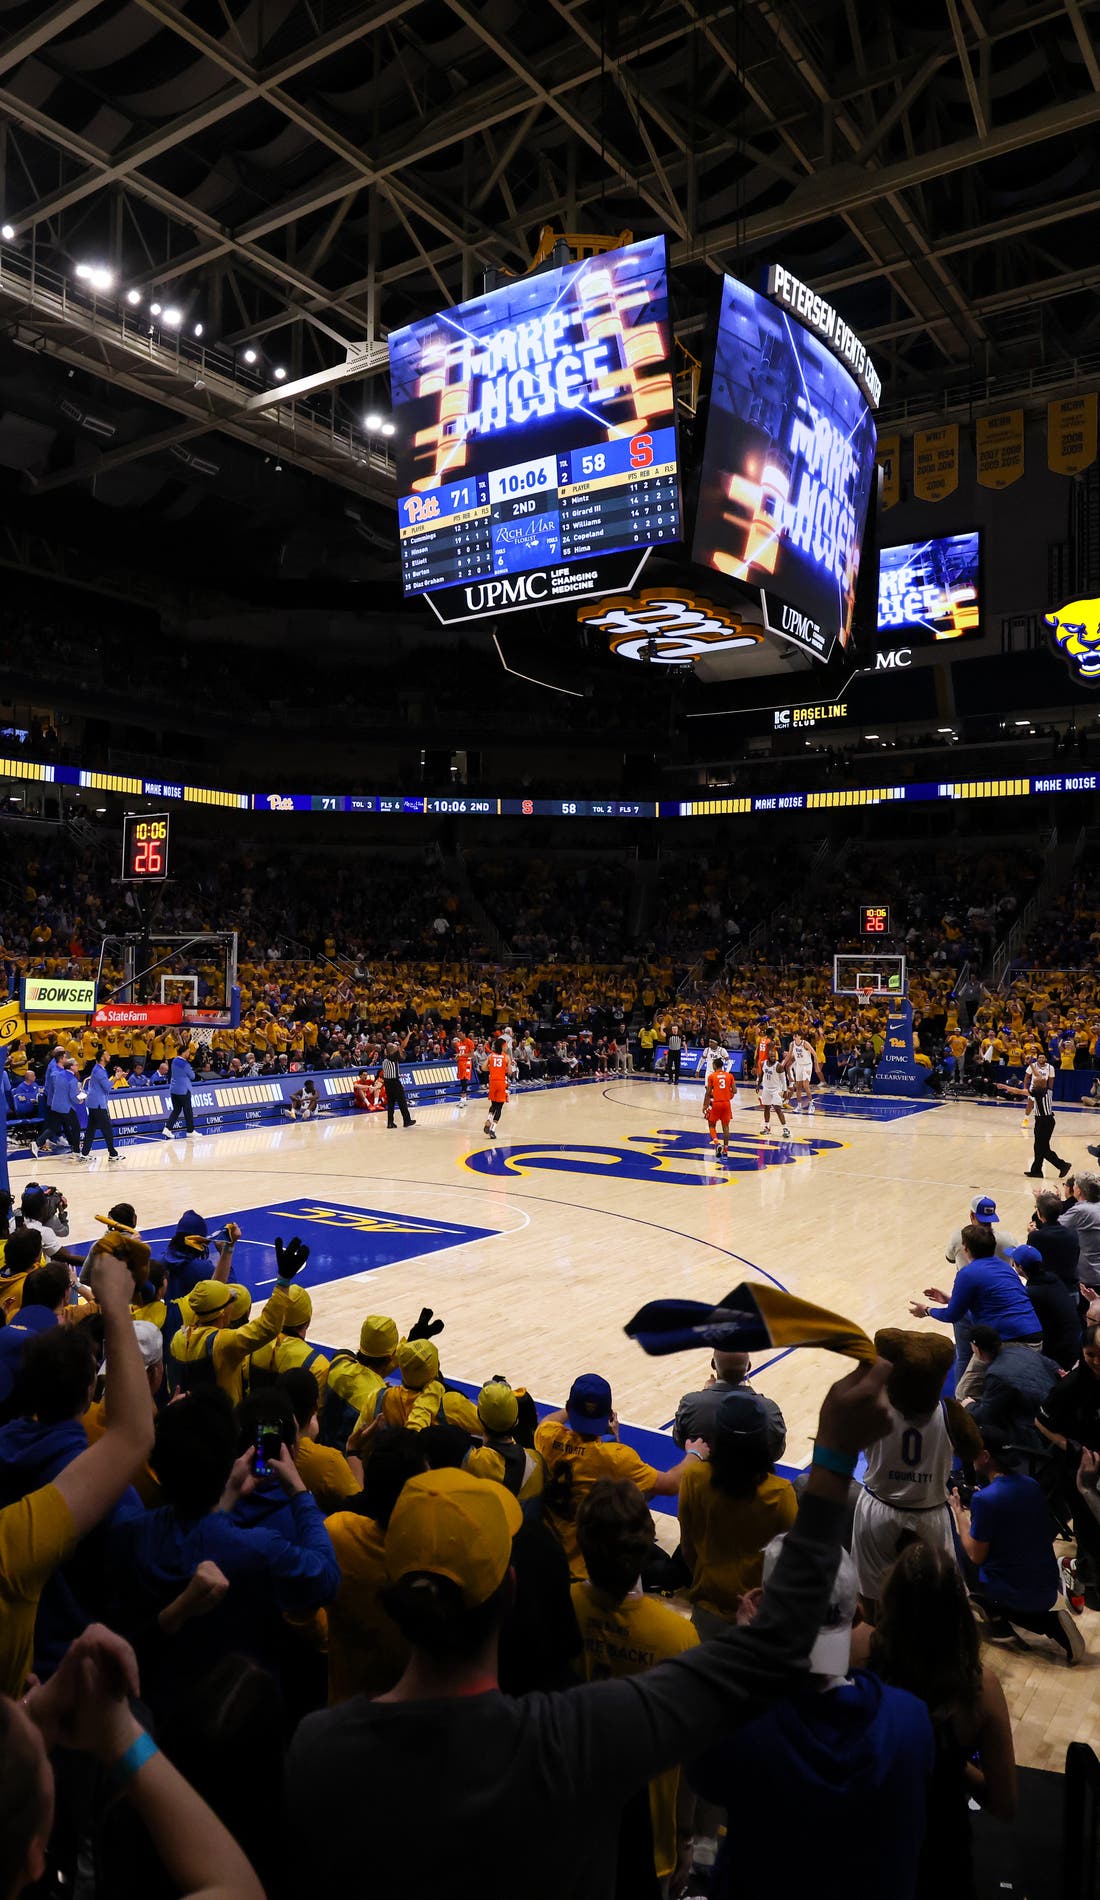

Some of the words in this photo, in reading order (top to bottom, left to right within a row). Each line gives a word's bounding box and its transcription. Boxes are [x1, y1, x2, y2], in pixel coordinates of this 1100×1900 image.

[775, 264, 836, 337] PETERSEN
[834, 316, 866, 374] EVENTS
[582, 453, 605, 474] 58
[630, 434, 653, 469] S
[499, 468, 547, 495] 10:06
[562, 472, 568, 482] 2
[572, 483, 590, 492] PLAYER
[480, 492, 487, 502] 3
[572, 495, 589, 504] Mintz
[404, 496, 440, 524] Pitt
[451, 487, 469, 508] 71
[512, 500, 536, 515] 2ND
[572, 506, 593, 516] Girard
[573, 518, 601, 528] Williams
[411, 533, 437, 544] Cummings
[574, 529, 604, 541] Copeland
[550, 544, 556, 554] 7
[574, 545, 590, 553] Hima
[498, 556, 504, 565] 6
[551, 568, 569, 578] LIFE
[552, 571, 598, 586] CHANGING
[464, 572, 548, 610] UPMC
[552, 580, 594, 594] MEDICINE
[782, 605, 814, 642] UPMC
[875, 650, 911, 670] MC
[774, 710, 790, 724] IC
[793, 704, 847, 722] BASELINE
[145, 782, 162, 796] MAKE
[163, 785, 181, 798] NOISE
[1034, 779, 1062, 792] MAKE
[1065, 777, 1096, 790] NOISE
[267, 794, 294, 810] Pitt
[322, 799, 336, 810] 71
[434, 800, 466, 812] 10:06
[470, 803, 489, 811] 2ND
[522, 800, 533, 814] S
[562, 803, 576, 814] 58
[755, 798, 776, 810] MAKE
[778, 796, 803, 808] NOISE
[136, 822, 166, 840] 10:06
[135, 842, 160, 871] 26
[867, 918, 883, 930] 26
[37, 988, 94, 1002] BOWSER
[889, 1038, 906, 1048] Pitt
[493, 1058, 502, 1067] 13
[719, 1079, 726, 1088] 3
[245, 1111, 262, 1119] UPMC
[119, 1126, 138, 1135] UPMC
[903, 1428, 922, 1466] 0
